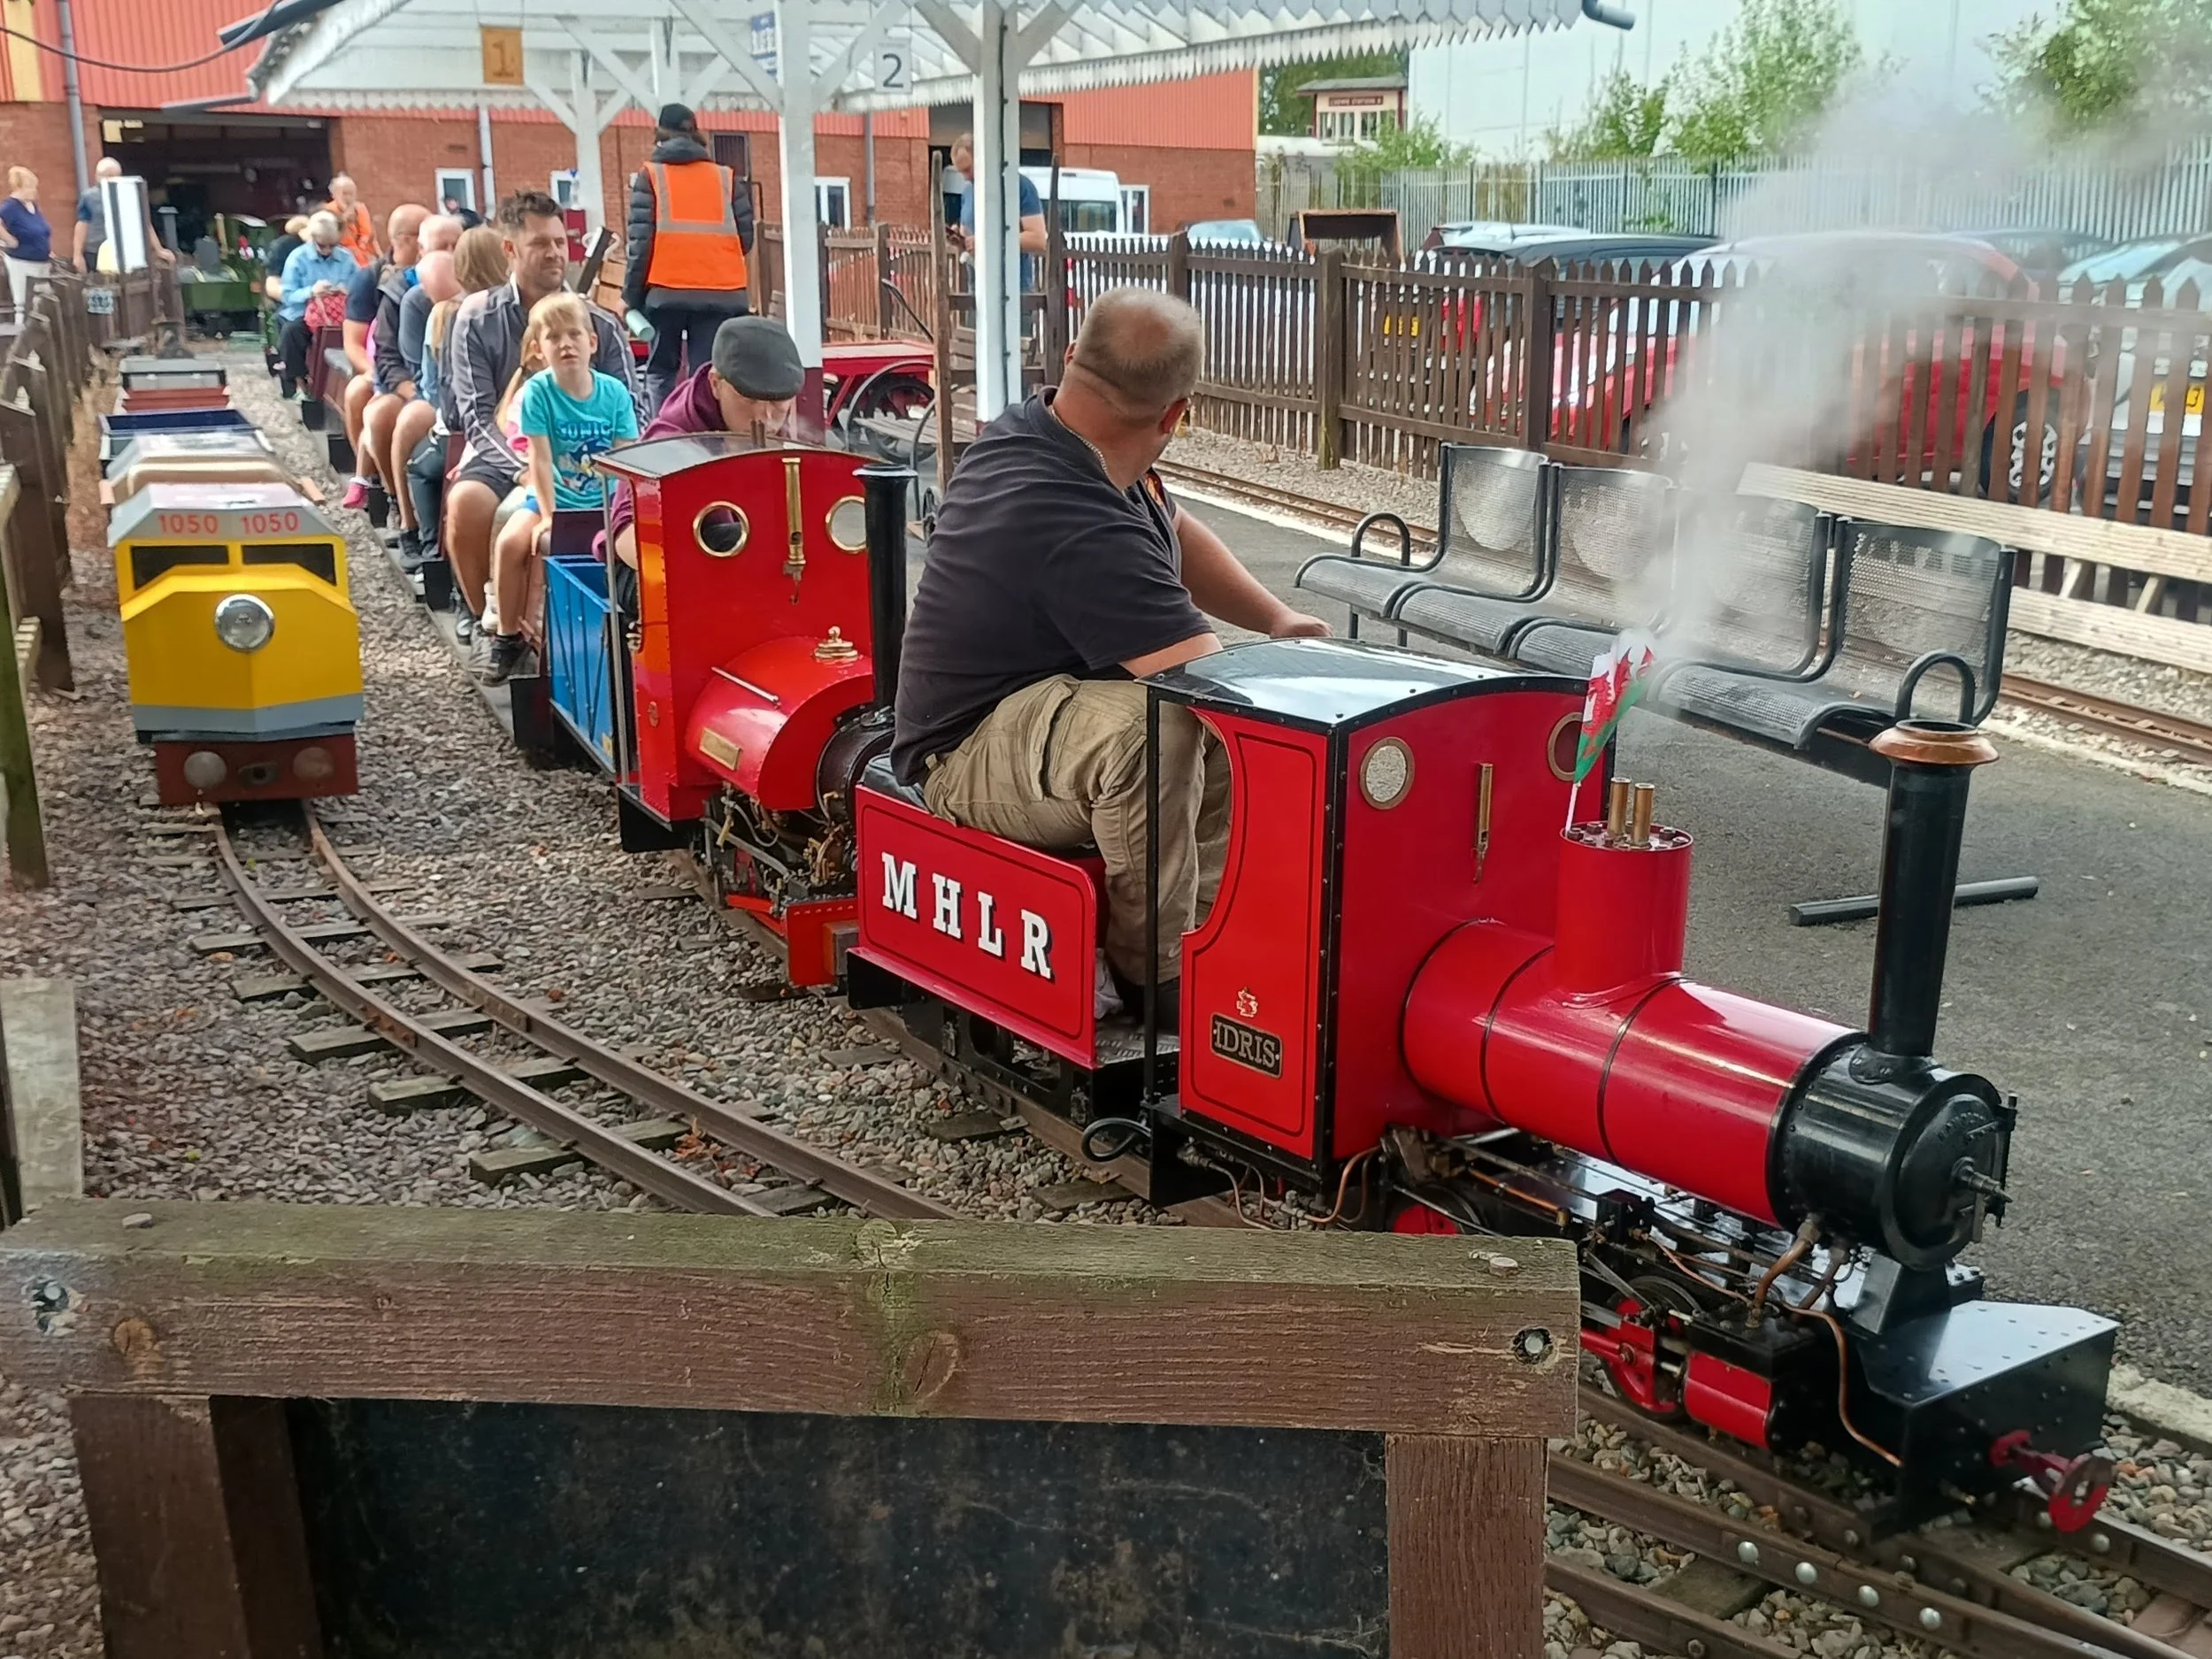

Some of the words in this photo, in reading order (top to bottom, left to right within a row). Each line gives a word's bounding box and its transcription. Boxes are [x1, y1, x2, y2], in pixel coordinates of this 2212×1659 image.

[491, 40, 514, 78] 1
[882, 53, 903, 88] 2
[157, 513, 219, 534] 1050
[241, 511, 300, 535] 1050
[1214, 1019, 1275, 1068] IDRIS
